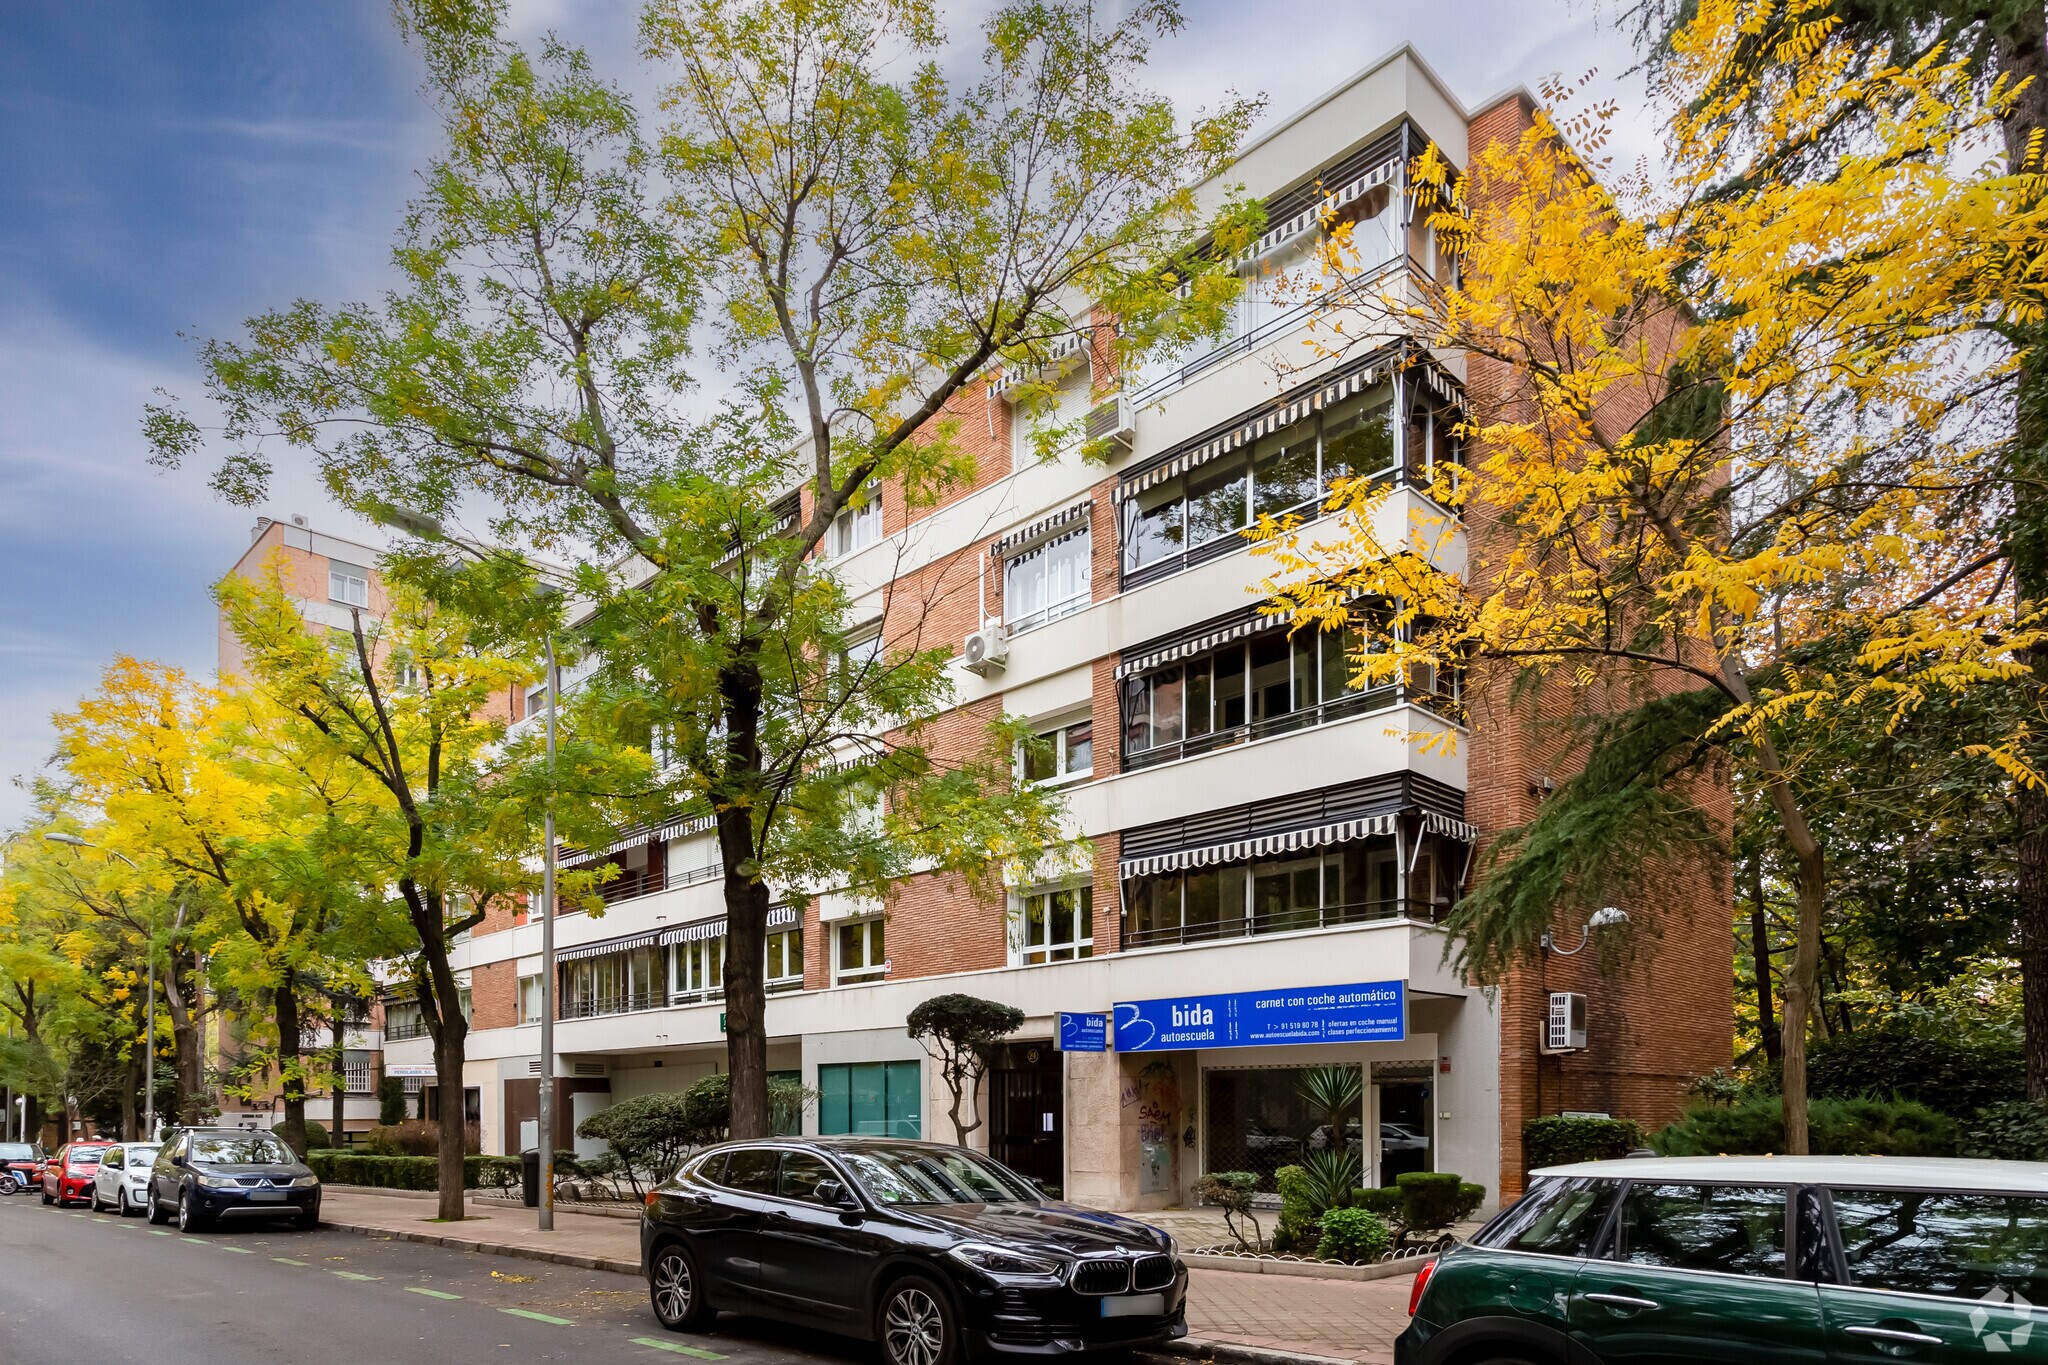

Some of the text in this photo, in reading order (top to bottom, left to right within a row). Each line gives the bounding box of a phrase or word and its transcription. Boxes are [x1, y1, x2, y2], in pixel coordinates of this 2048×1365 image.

[1256, 989, 1396, 1009] carnet con coche automático
[1172, 1003, 1213, 1027] bida
[1086, 1017, 1103, 1027] bida
[1290, 1021, 1301, 1029] 519
[1357, 1018, 1375, 1026] coche
[1161, 1028, 1214, 1042] autoescuela
[1249, 1030, 1320, 1039] www.autoescuelabida.com
[1327, 1026, 1398, 1036] clases perfeccionamiento
